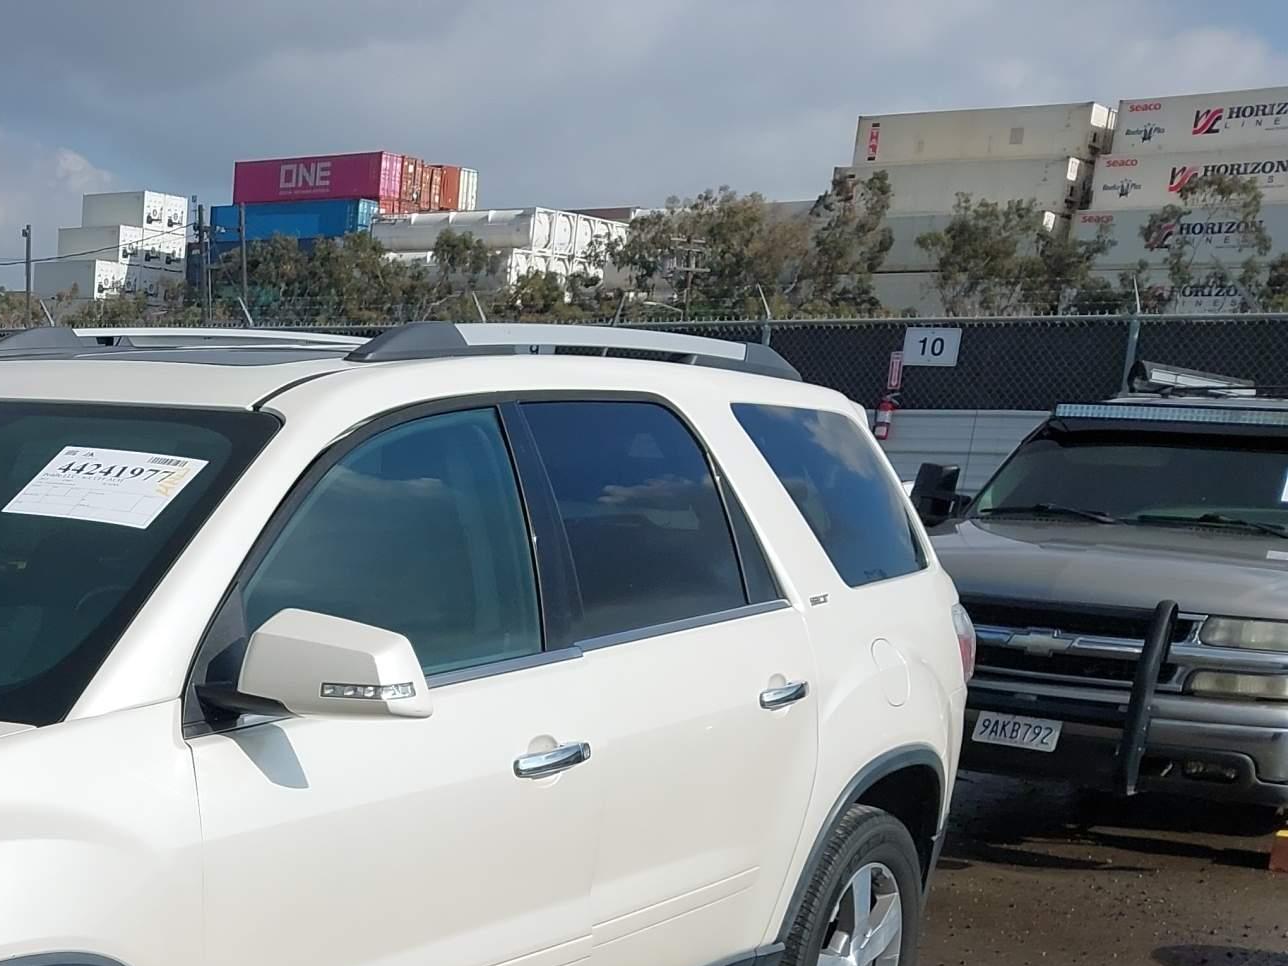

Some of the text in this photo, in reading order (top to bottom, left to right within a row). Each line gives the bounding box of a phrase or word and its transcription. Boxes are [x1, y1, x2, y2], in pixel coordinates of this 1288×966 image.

[1128, 102, 1162, 113] seaco
[1106, 158, 1138, 168] seaco
[1203, 160, 1288, 177] HORIZON
[279, 161, 331, 188] ONE
[918, 337, 945, 357] 10
[57, 461, 176, 483] 44241977
[978, 718, 1054, 745] 9AKB792
